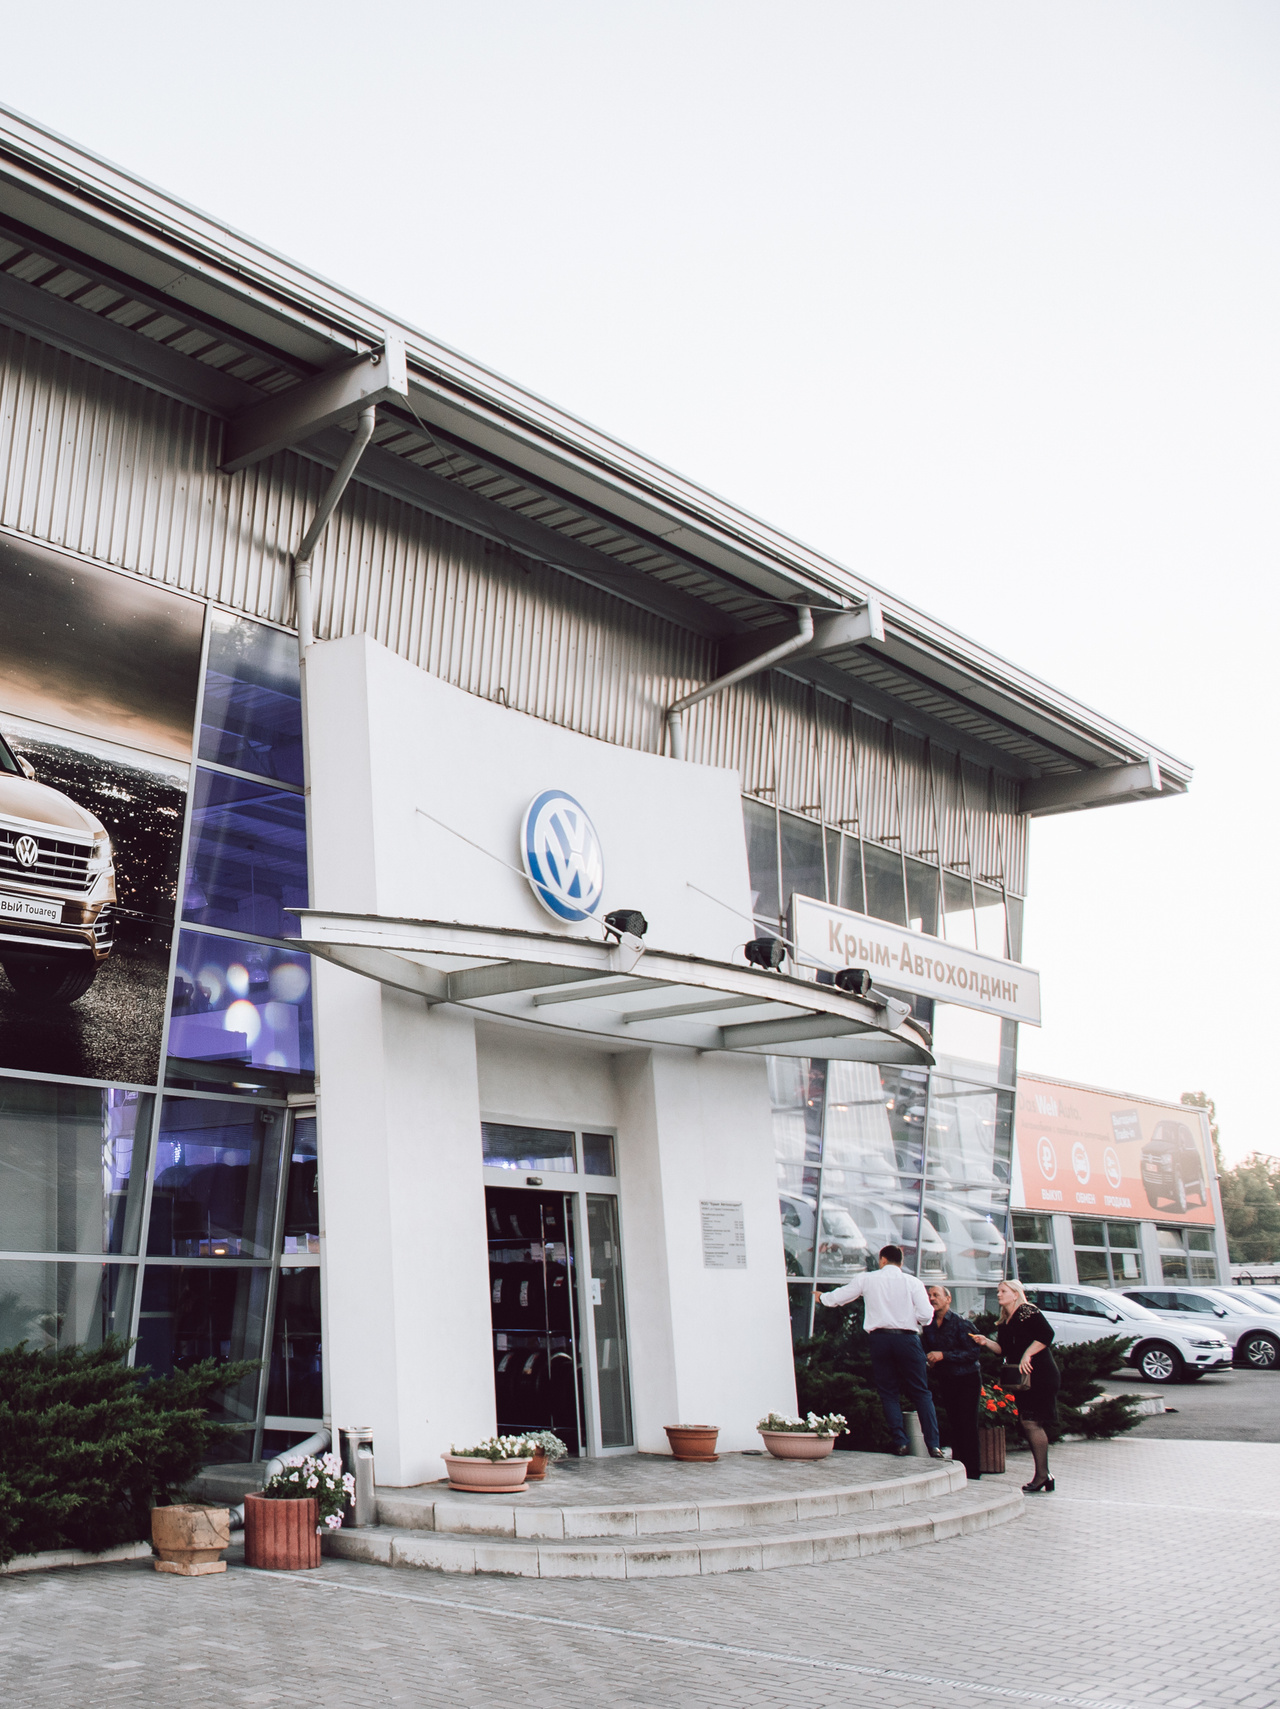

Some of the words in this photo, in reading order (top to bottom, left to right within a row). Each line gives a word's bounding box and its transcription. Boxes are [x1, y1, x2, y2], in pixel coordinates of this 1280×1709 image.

[526, 789, 604, 921] VW
[25, 903, 57, 920] Touareg
[828, 919, 1019, 1003] Крым-Автохолдинг
[1035, 1094, 1058, 1117] Welt
[1041, 1188, 1063, 1202] ВЫКУП
[1075, 1192, 1096, 1205] ОБМЕН
[1104, 1195, 1132, 1208] ПРОДАЖА
